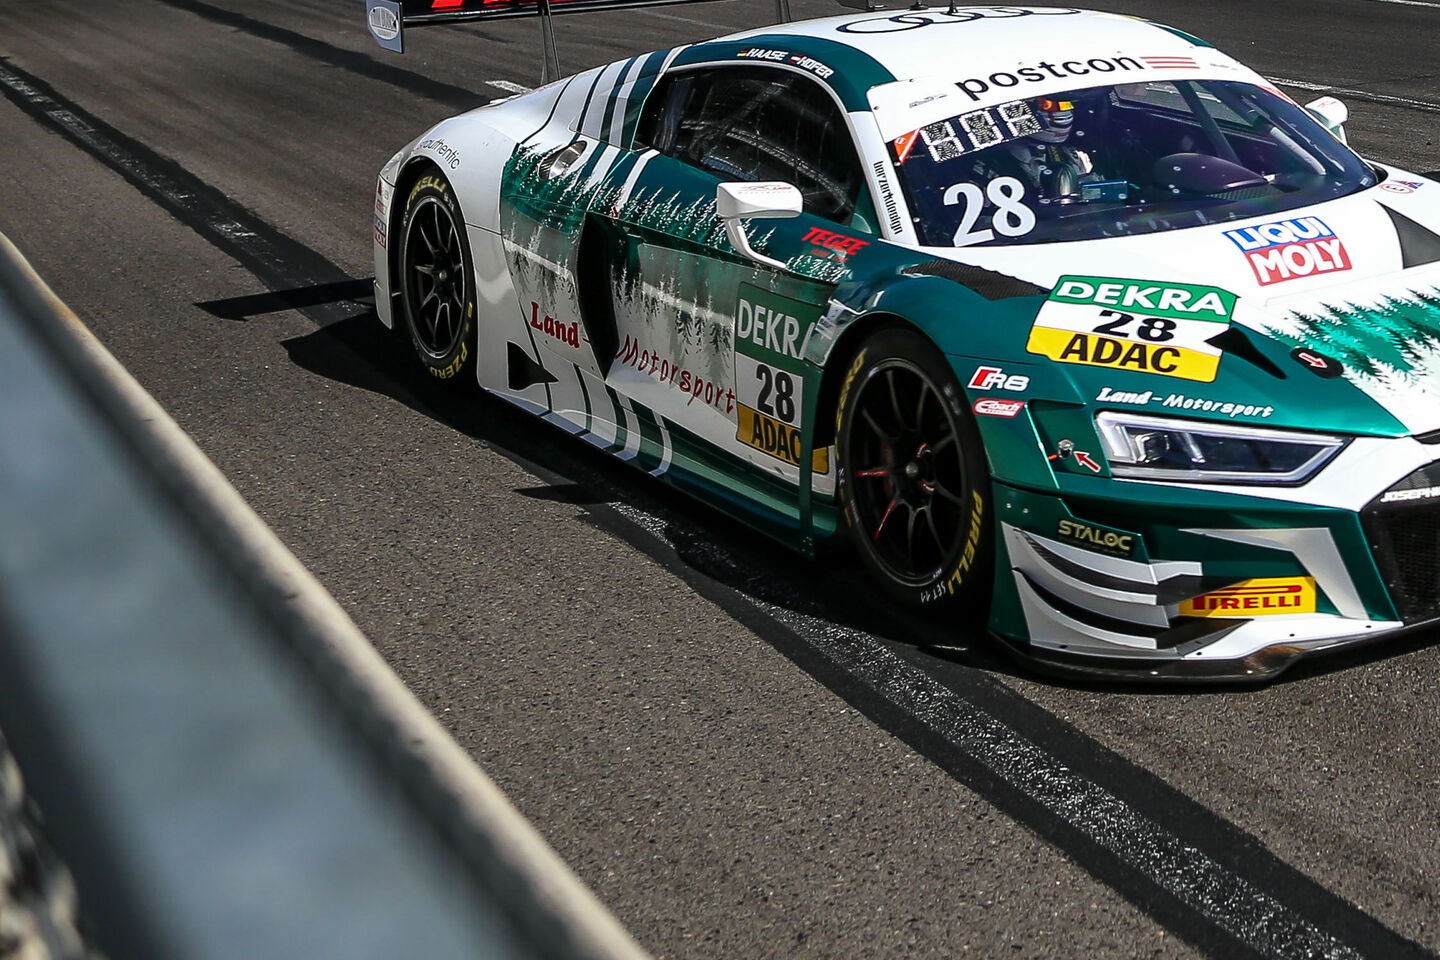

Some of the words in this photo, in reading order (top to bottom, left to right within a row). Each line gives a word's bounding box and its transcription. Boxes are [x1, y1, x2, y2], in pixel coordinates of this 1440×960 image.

[745, 48, 789, 61] HAASE
[954, 51, 1145, 102] postcon
[943, 176, 1036, 247] 28
[1227, 217, 1334, 251] LIQUI
[1249, 238, 1349, 283] MOLY
[1056, 281, 1228, 316] DEKRA
[1092, 309, 1177, 342] 28
[615, 333, 736, 406] Motorsport
[1059, 333, 1181, 373] ADAC
[756, 363, 795, 423] 28
[970, 367, 1030, 391] R8
[751, 413, 801, 465] ADAC
[947, 489, 984, 596] PIRELLI
[1058, 520, 1132, 551] STALOC
[1191, 585, 1302, 611] PIRELLI
